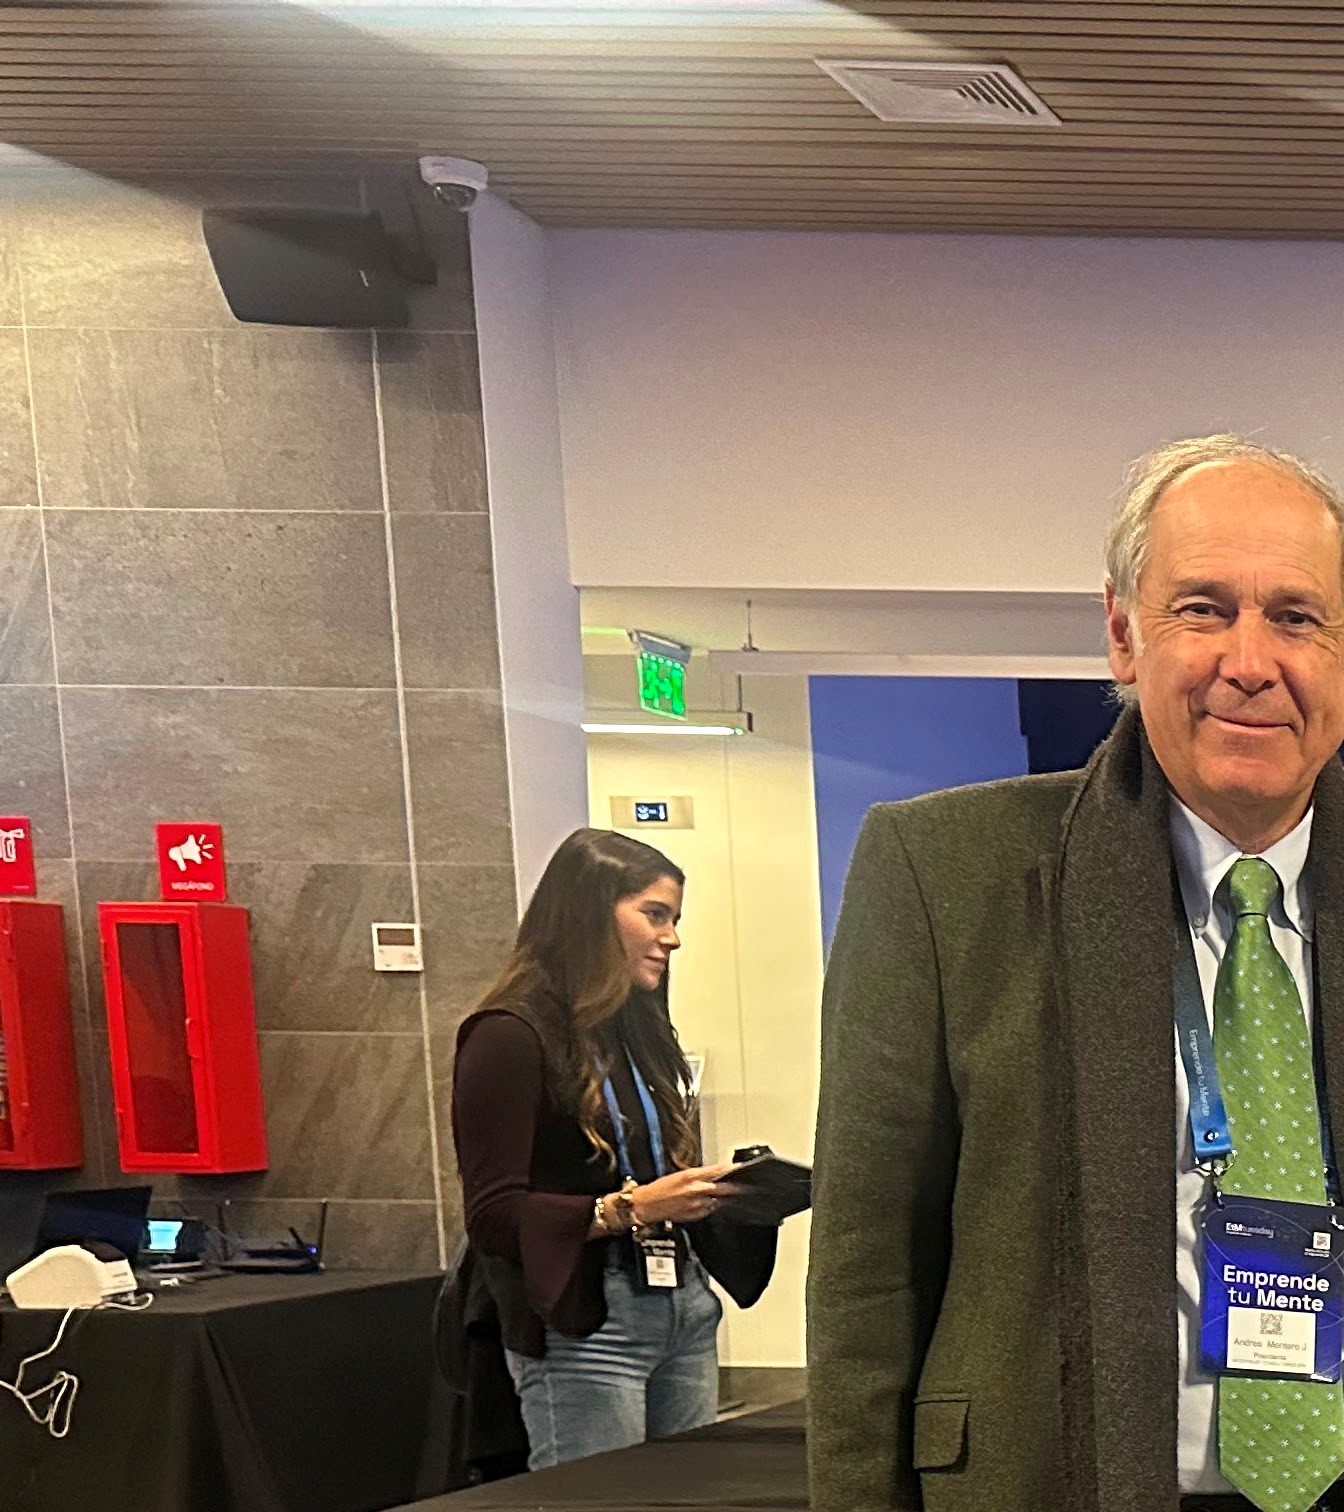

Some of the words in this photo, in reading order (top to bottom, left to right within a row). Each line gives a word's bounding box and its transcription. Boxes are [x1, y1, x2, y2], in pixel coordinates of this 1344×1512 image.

[1223, 1264, 1330, 1292] Emprende
[1227, 1286, 1251, 1305] tu
[1257, 1288, 1324, 1312] Mente
